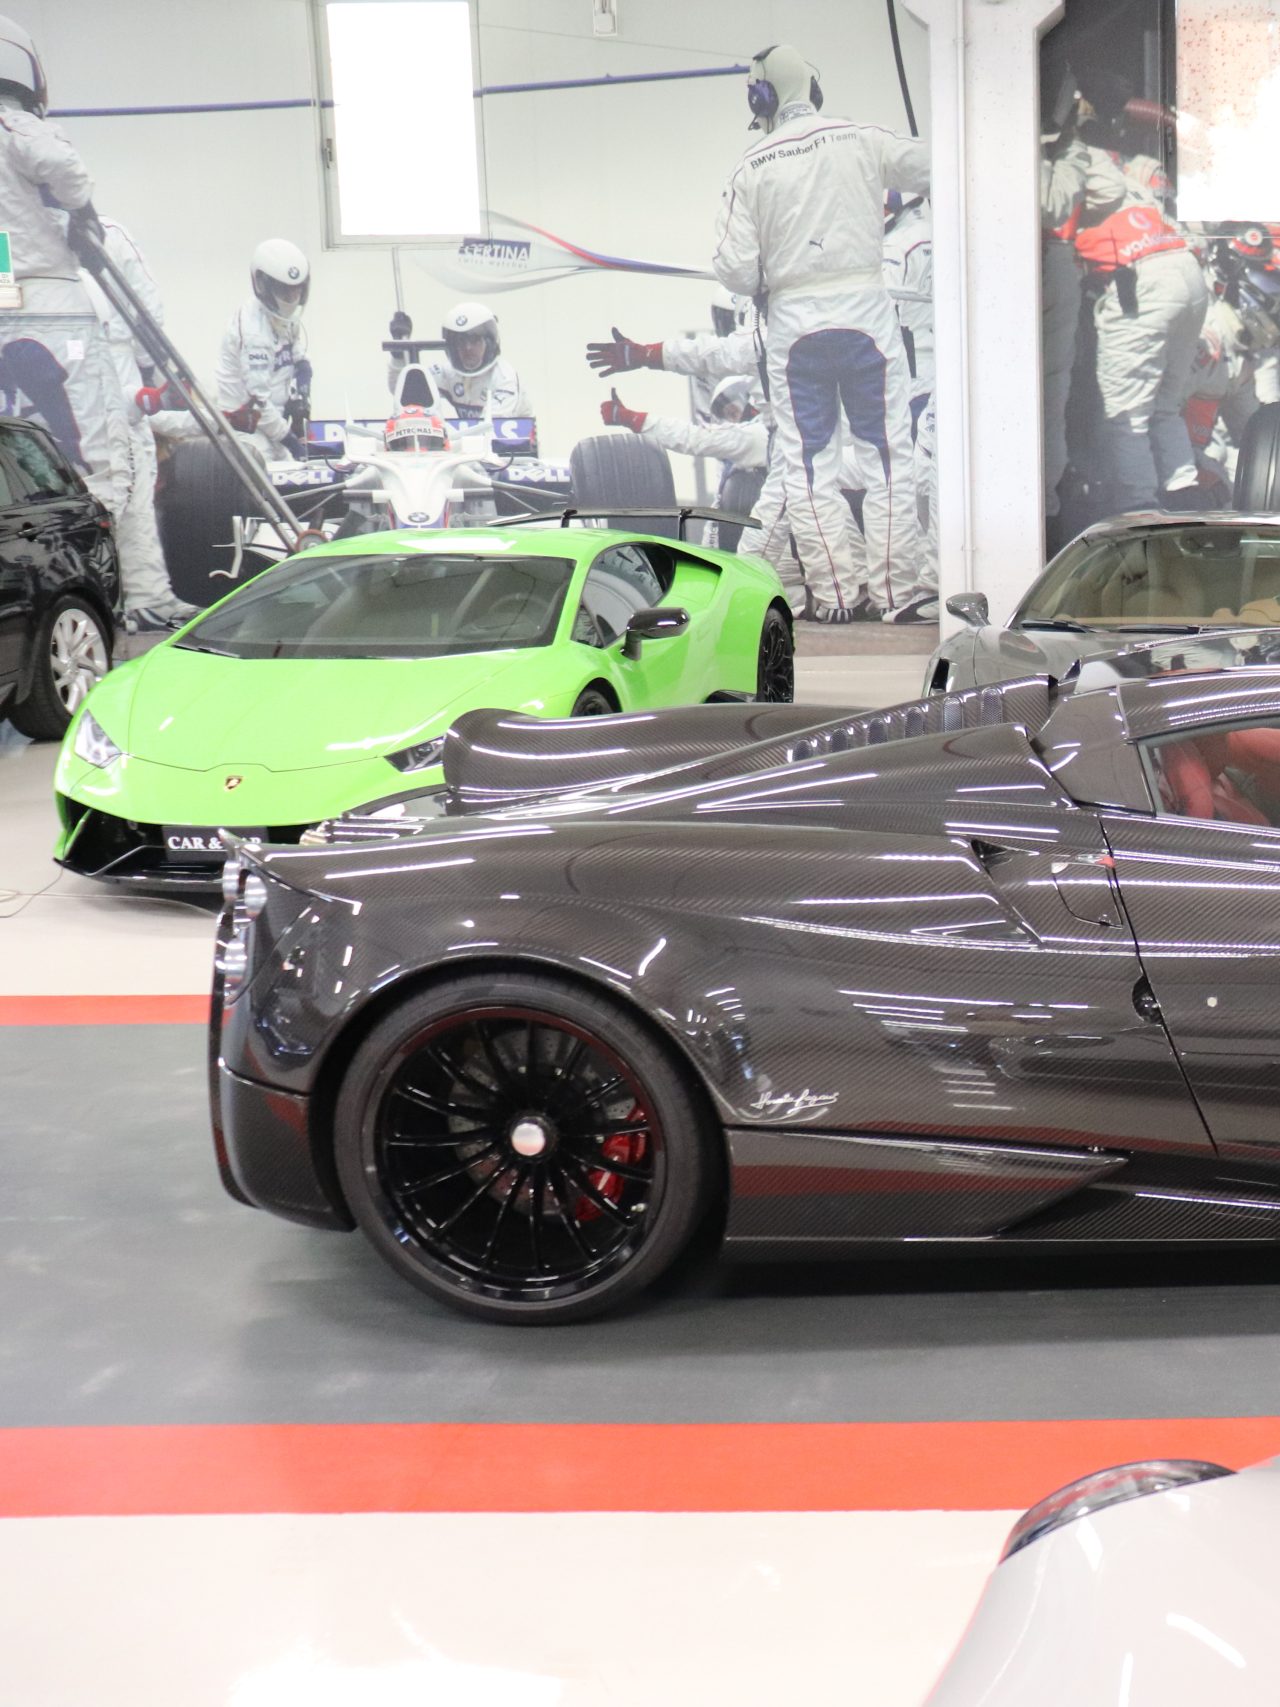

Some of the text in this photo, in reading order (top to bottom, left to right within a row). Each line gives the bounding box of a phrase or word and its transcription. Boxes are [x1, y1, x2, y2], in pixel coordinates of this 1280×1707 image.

[750, 132, 857, 169] BMW Sauber F1 Team
[272, 470, 334, 486] DELL
[508, 468, 571, 483] DELL
[167, 836, 207, 850] CAR
[208, 837, 223, 849] &
